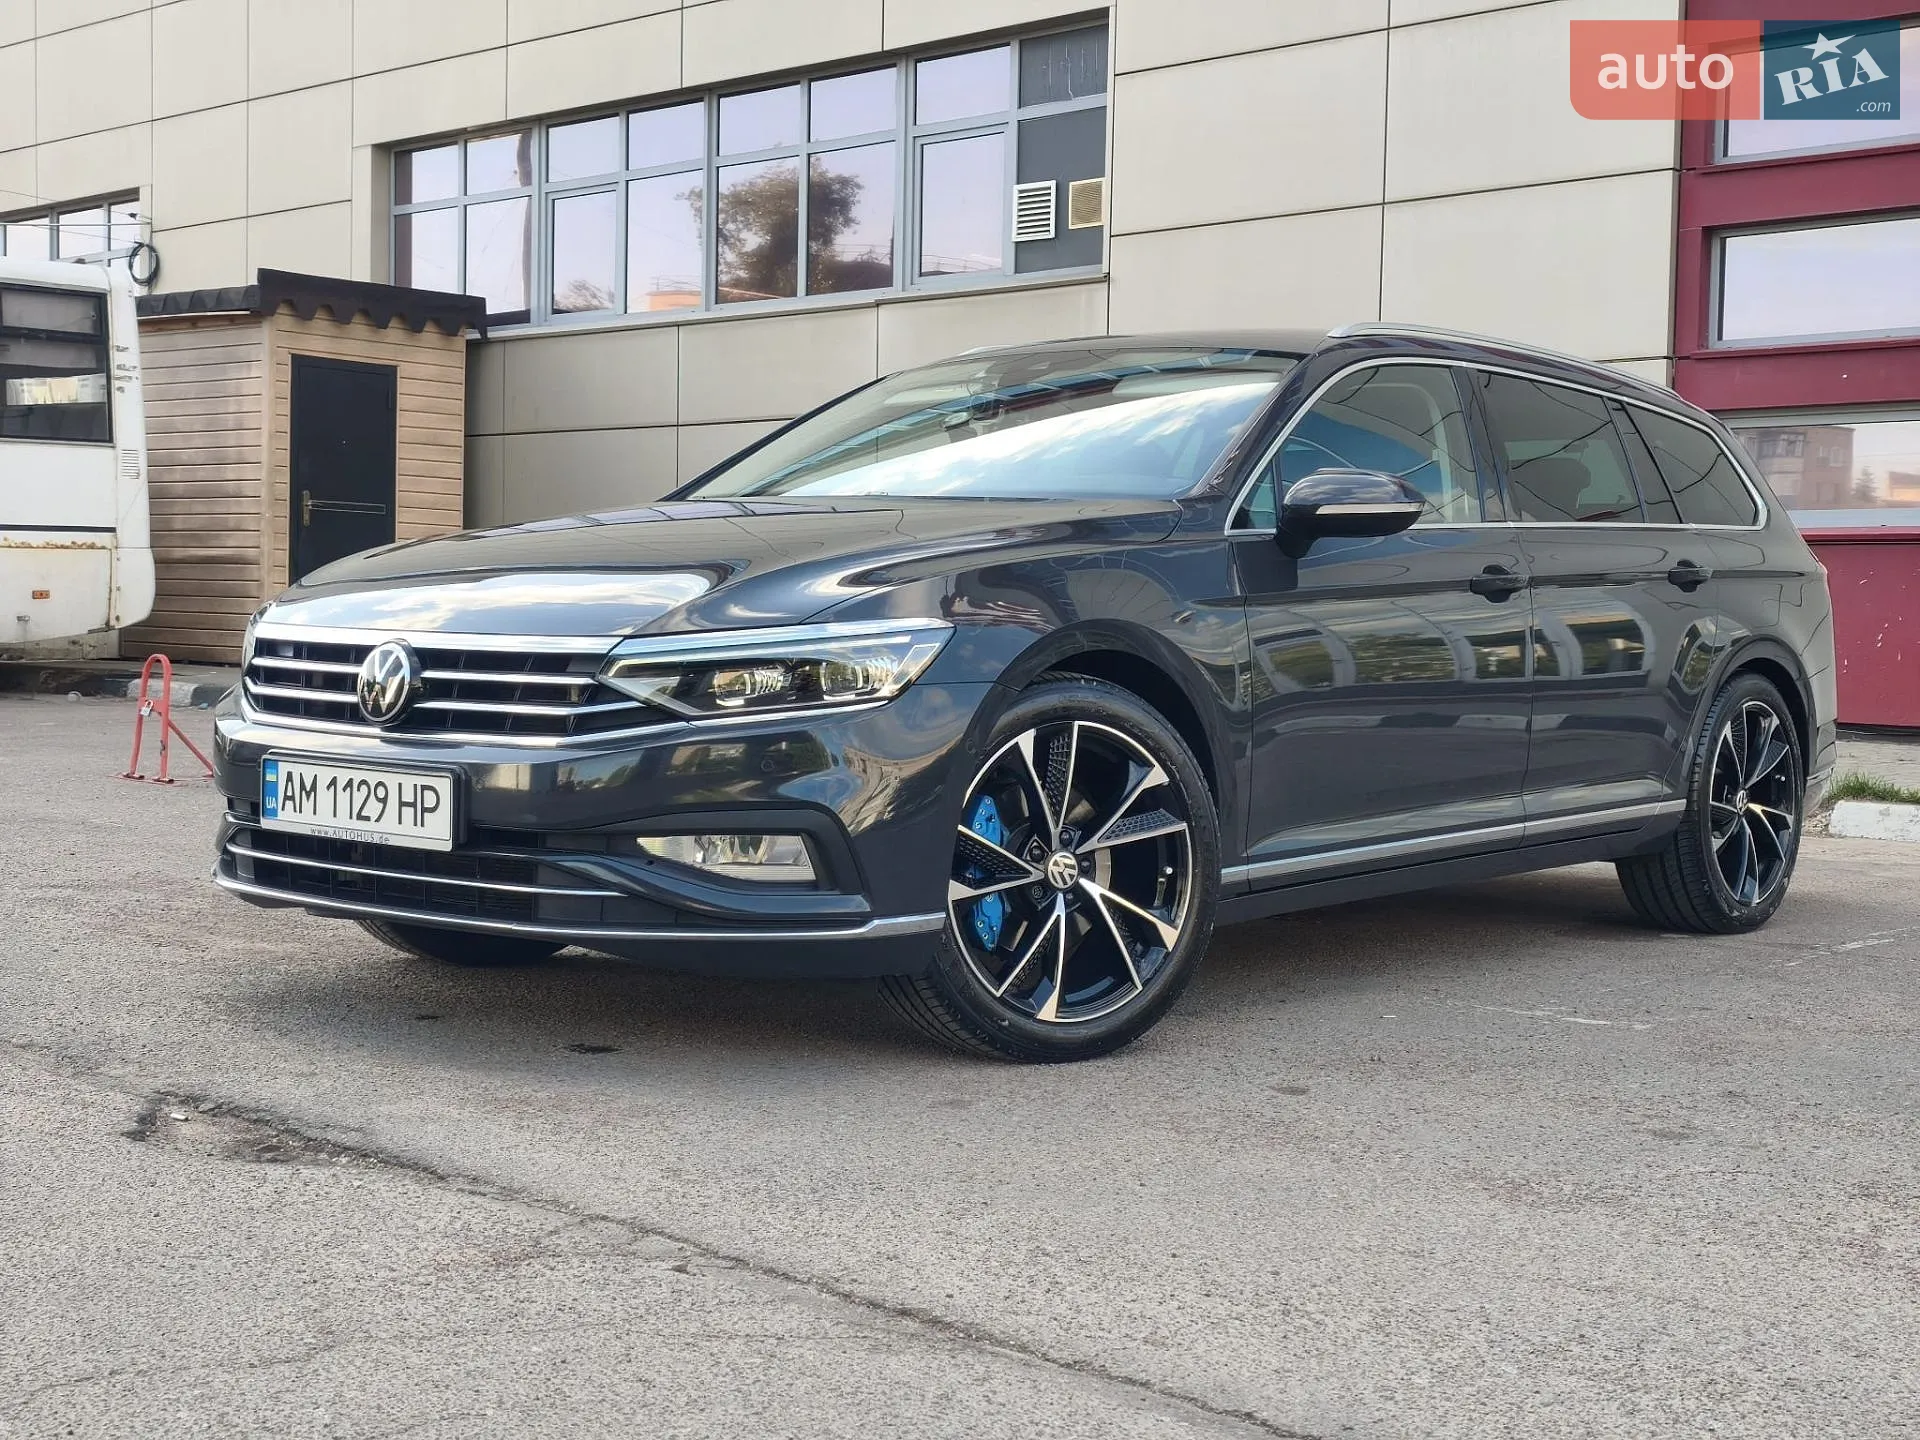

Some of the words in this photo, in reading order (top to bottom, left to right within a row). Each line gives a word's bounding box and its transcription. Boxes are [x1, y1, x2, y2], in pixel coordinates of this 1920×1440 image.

[266, 797, 277, 809] UA
[281, 771, 317, 815] AM
[326, 775, 389, 823] 1129
[398, 782, 440, 828] HP
[311, 827, 390, 844] www.AUTOHUS.de
